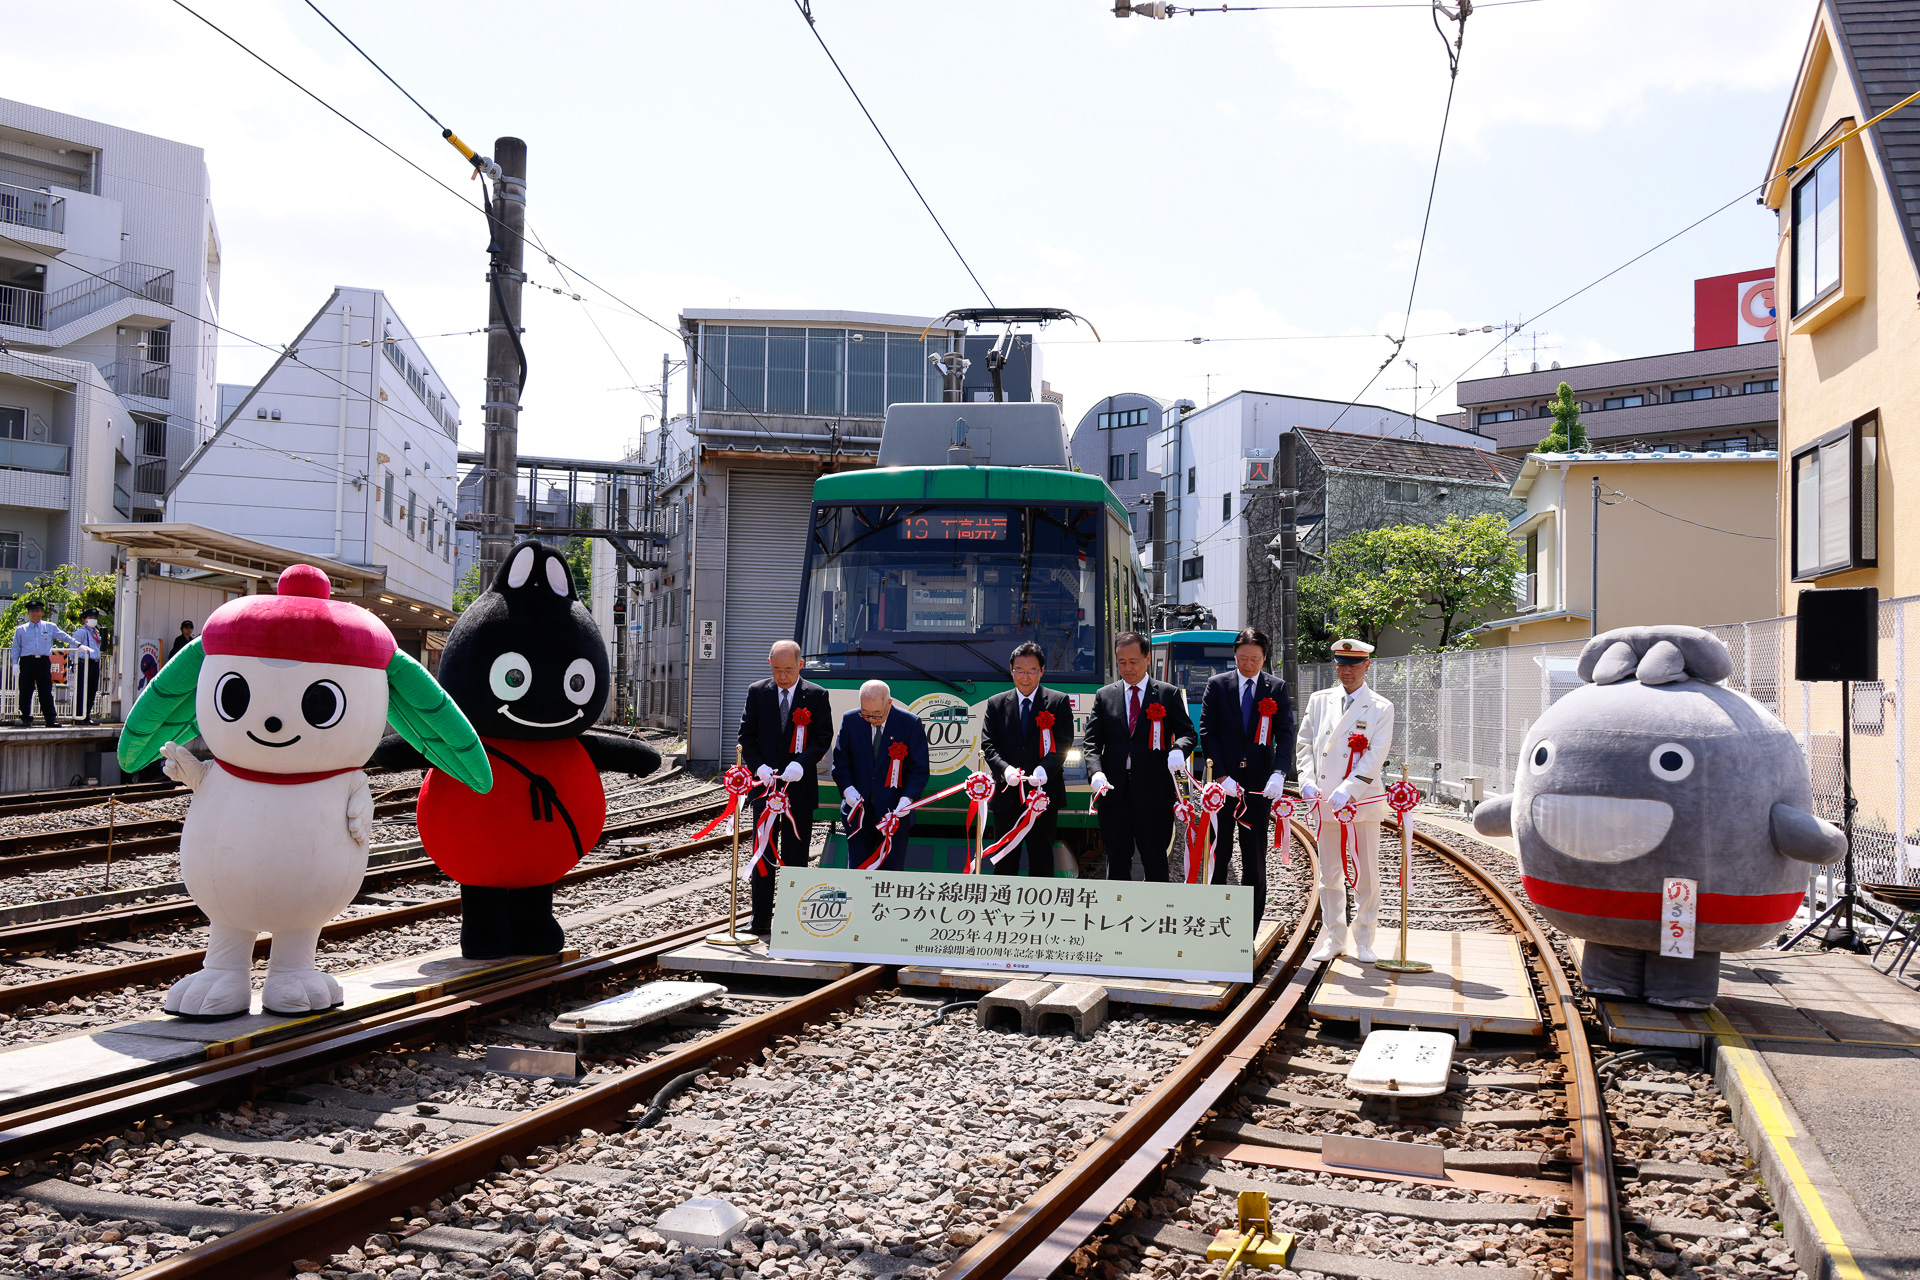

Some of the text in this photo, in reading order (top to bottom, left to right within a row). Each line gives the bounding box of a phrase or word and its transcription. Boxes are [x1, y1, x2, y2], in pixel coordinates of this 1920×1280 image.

[923, 720, 962, 746] 00
[871, 881, 1098, 909] 世田谷線開通100周年
[810, 901, 842, 920] 100
[871, 902, 1232, 938] なつかしのギャラリートレイン出発式
[914, 945, 1103, 963] 世田谷線開通100周年記念事業実行委員会
